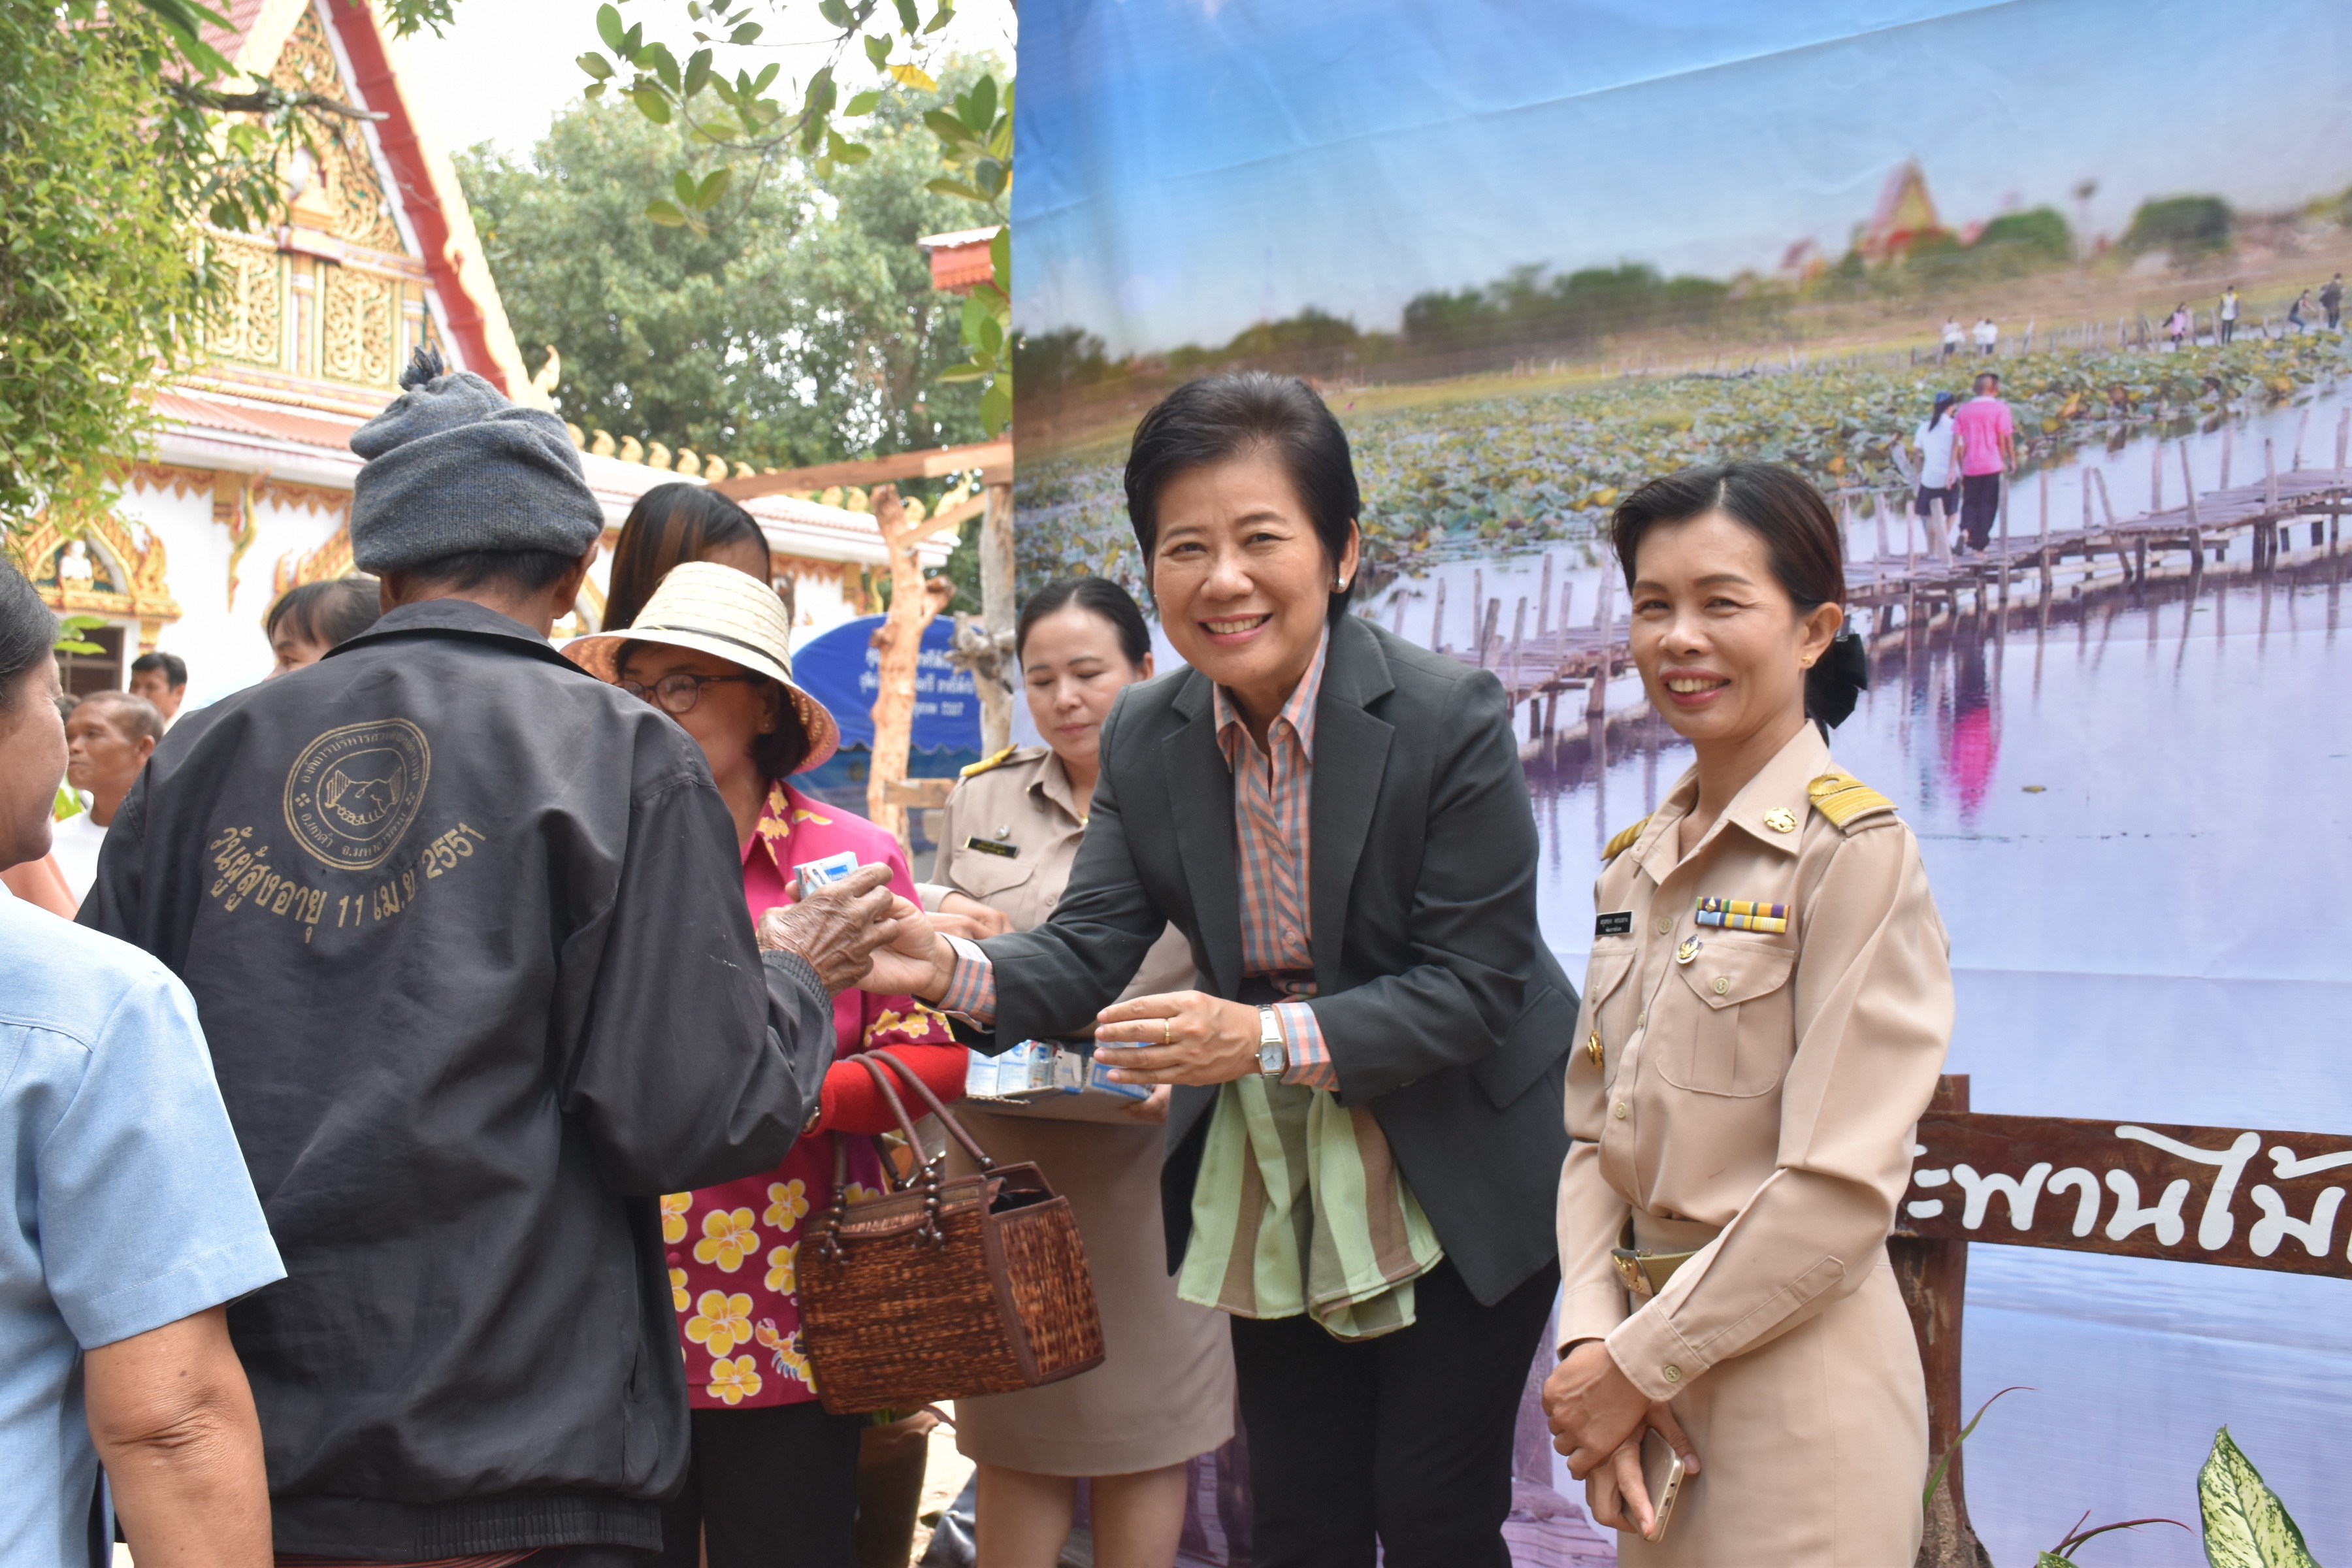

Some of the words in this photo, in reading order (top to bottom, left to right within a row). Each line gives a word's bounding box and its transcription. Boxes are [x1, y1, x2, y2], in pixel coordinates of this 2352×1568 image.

[210, 826, 327, 943] วันผู้สูงอายุ
[338, 894, 364, 928] 11
[421, 822, 486, 879] 2551
[1907, 1125, 2352, 1265] ะพานไม้
